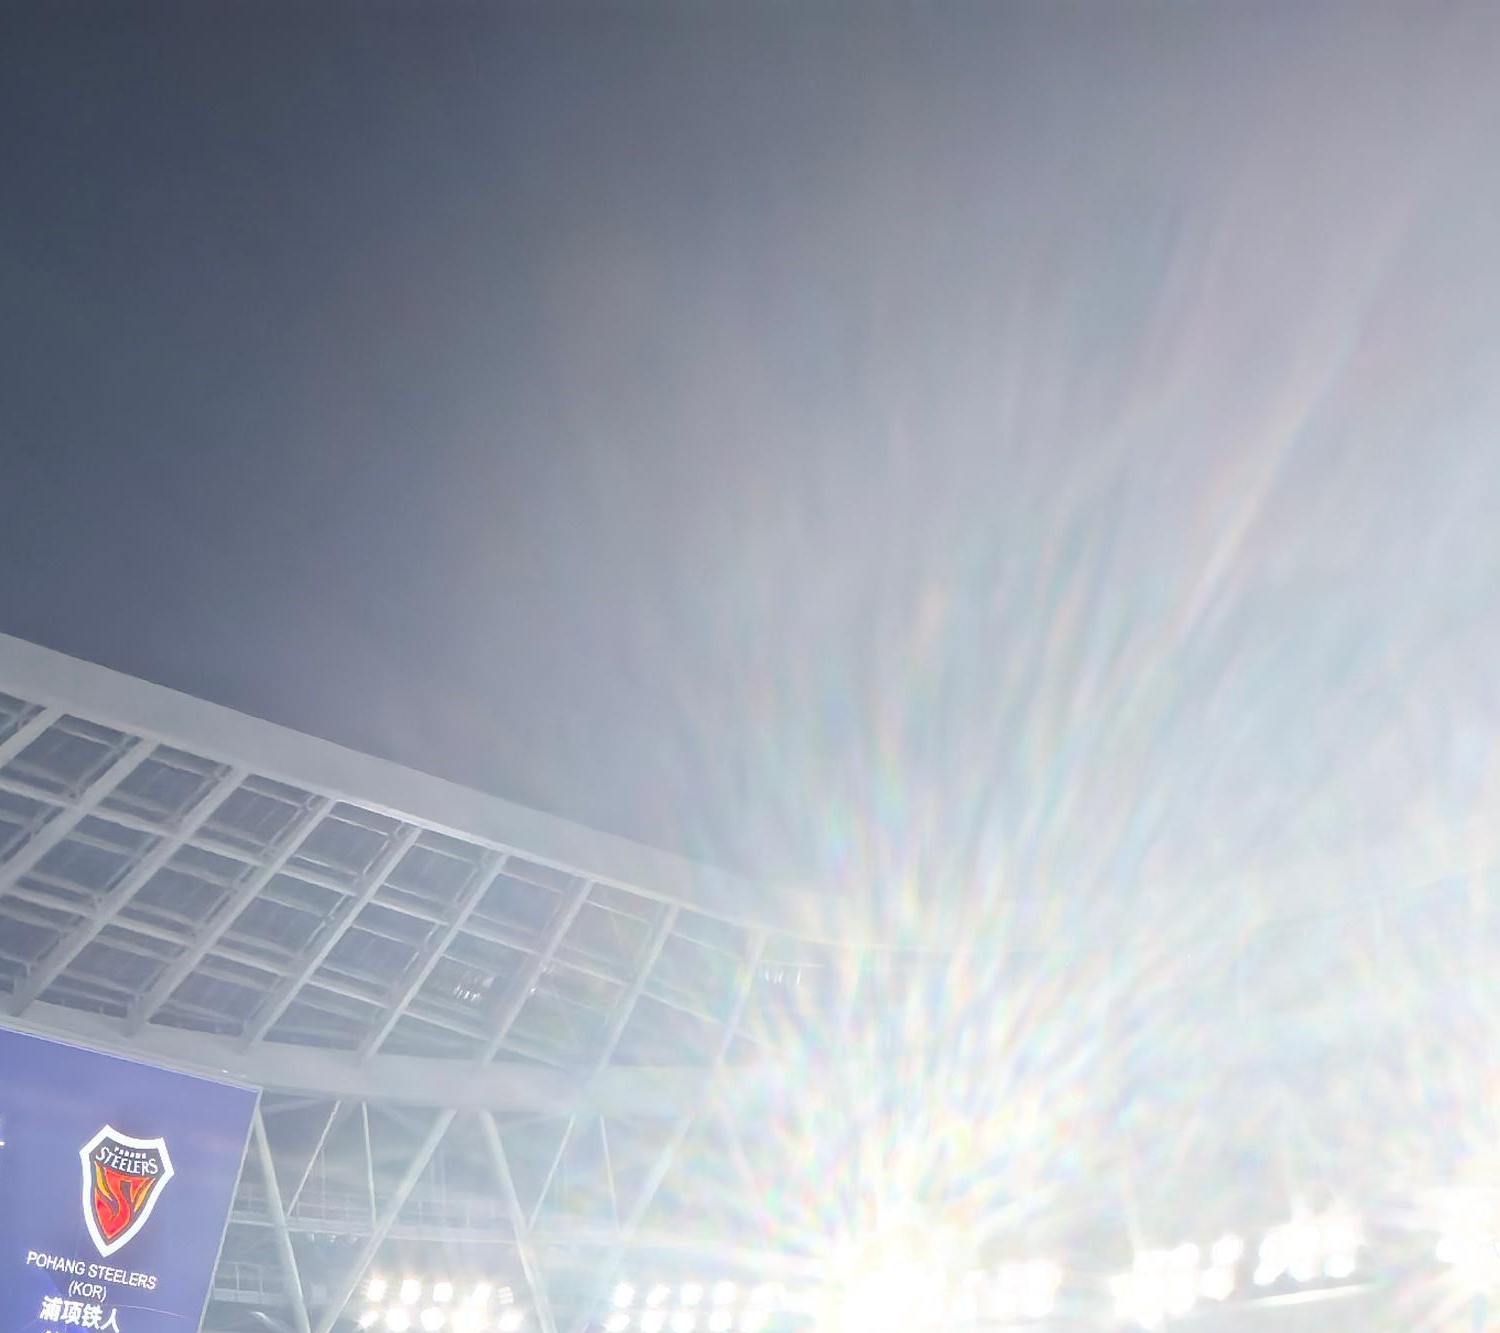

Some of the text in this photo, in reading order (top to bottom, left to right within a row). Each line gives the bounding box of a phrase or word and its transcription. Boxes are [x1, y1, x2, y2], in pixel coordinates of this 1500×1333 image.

[95, 1146, 159, 1176] STEELERS
[26, 1250, 157, 1290] POHANG STEELERS
[68, 1280, 107, 1303] (KOR)
[39, 1296, 120, 1333] 浦项铁人
